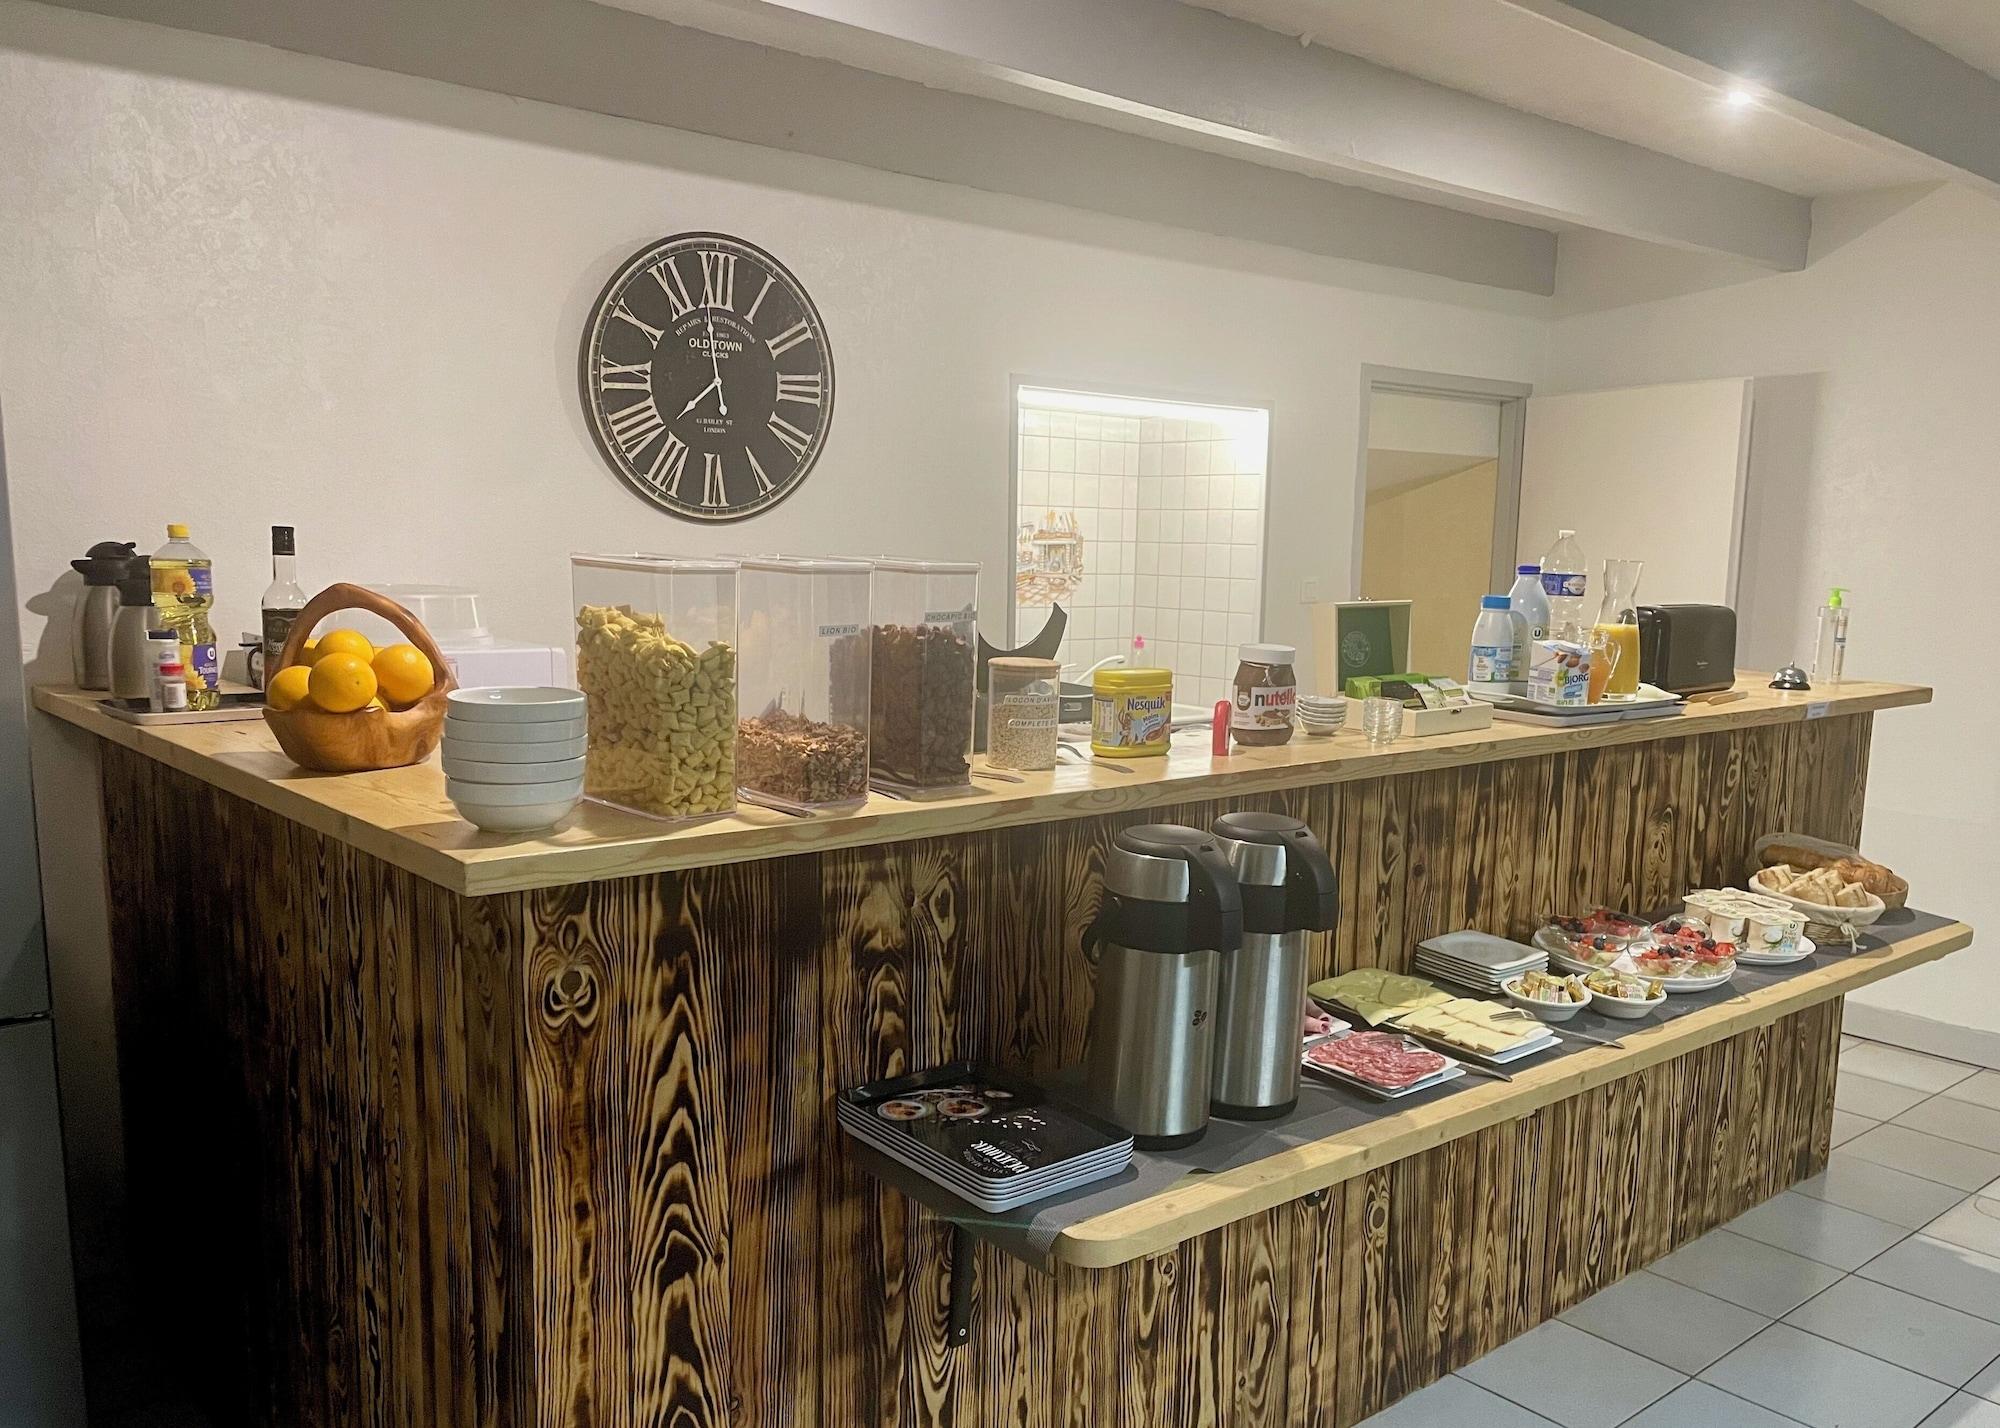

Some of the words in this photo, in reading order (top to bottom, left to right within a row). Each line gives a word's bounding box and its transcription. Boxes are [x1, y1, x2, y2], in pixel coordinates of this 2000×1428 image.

[647, 256, 696, 322] XI
[697, 250, 738, 312] XII
[743, 273, 776, 325] I
[612, 298, 664, 349] X
[675, 317, 702, 337] REPAIRS
[711, 315, 756, 344] RESTORATIONS
[765, 317, 813, 360] II
[689, 337, 711, 349] OLD
[712, 340, 743, 352] TOWN
[702, 350, 729, 359] CLCKS
[600, 354, 652, 393] IX
[775, 371, 821, 408] III
[606, 403, 667, 464] VIII
[643, 431, 690, 498] VII
[700, 453, 730, 507] VI
[745, 446, 776, 497] V
[821, 626, 841, 635] LION
[842, 626, 857, 634] BIO
[1564, 673, 1589, 686] BJORG
[1009, 719, 1049, 728] COMPLETE
[1127, 696, 1166, 714] Nesquik
